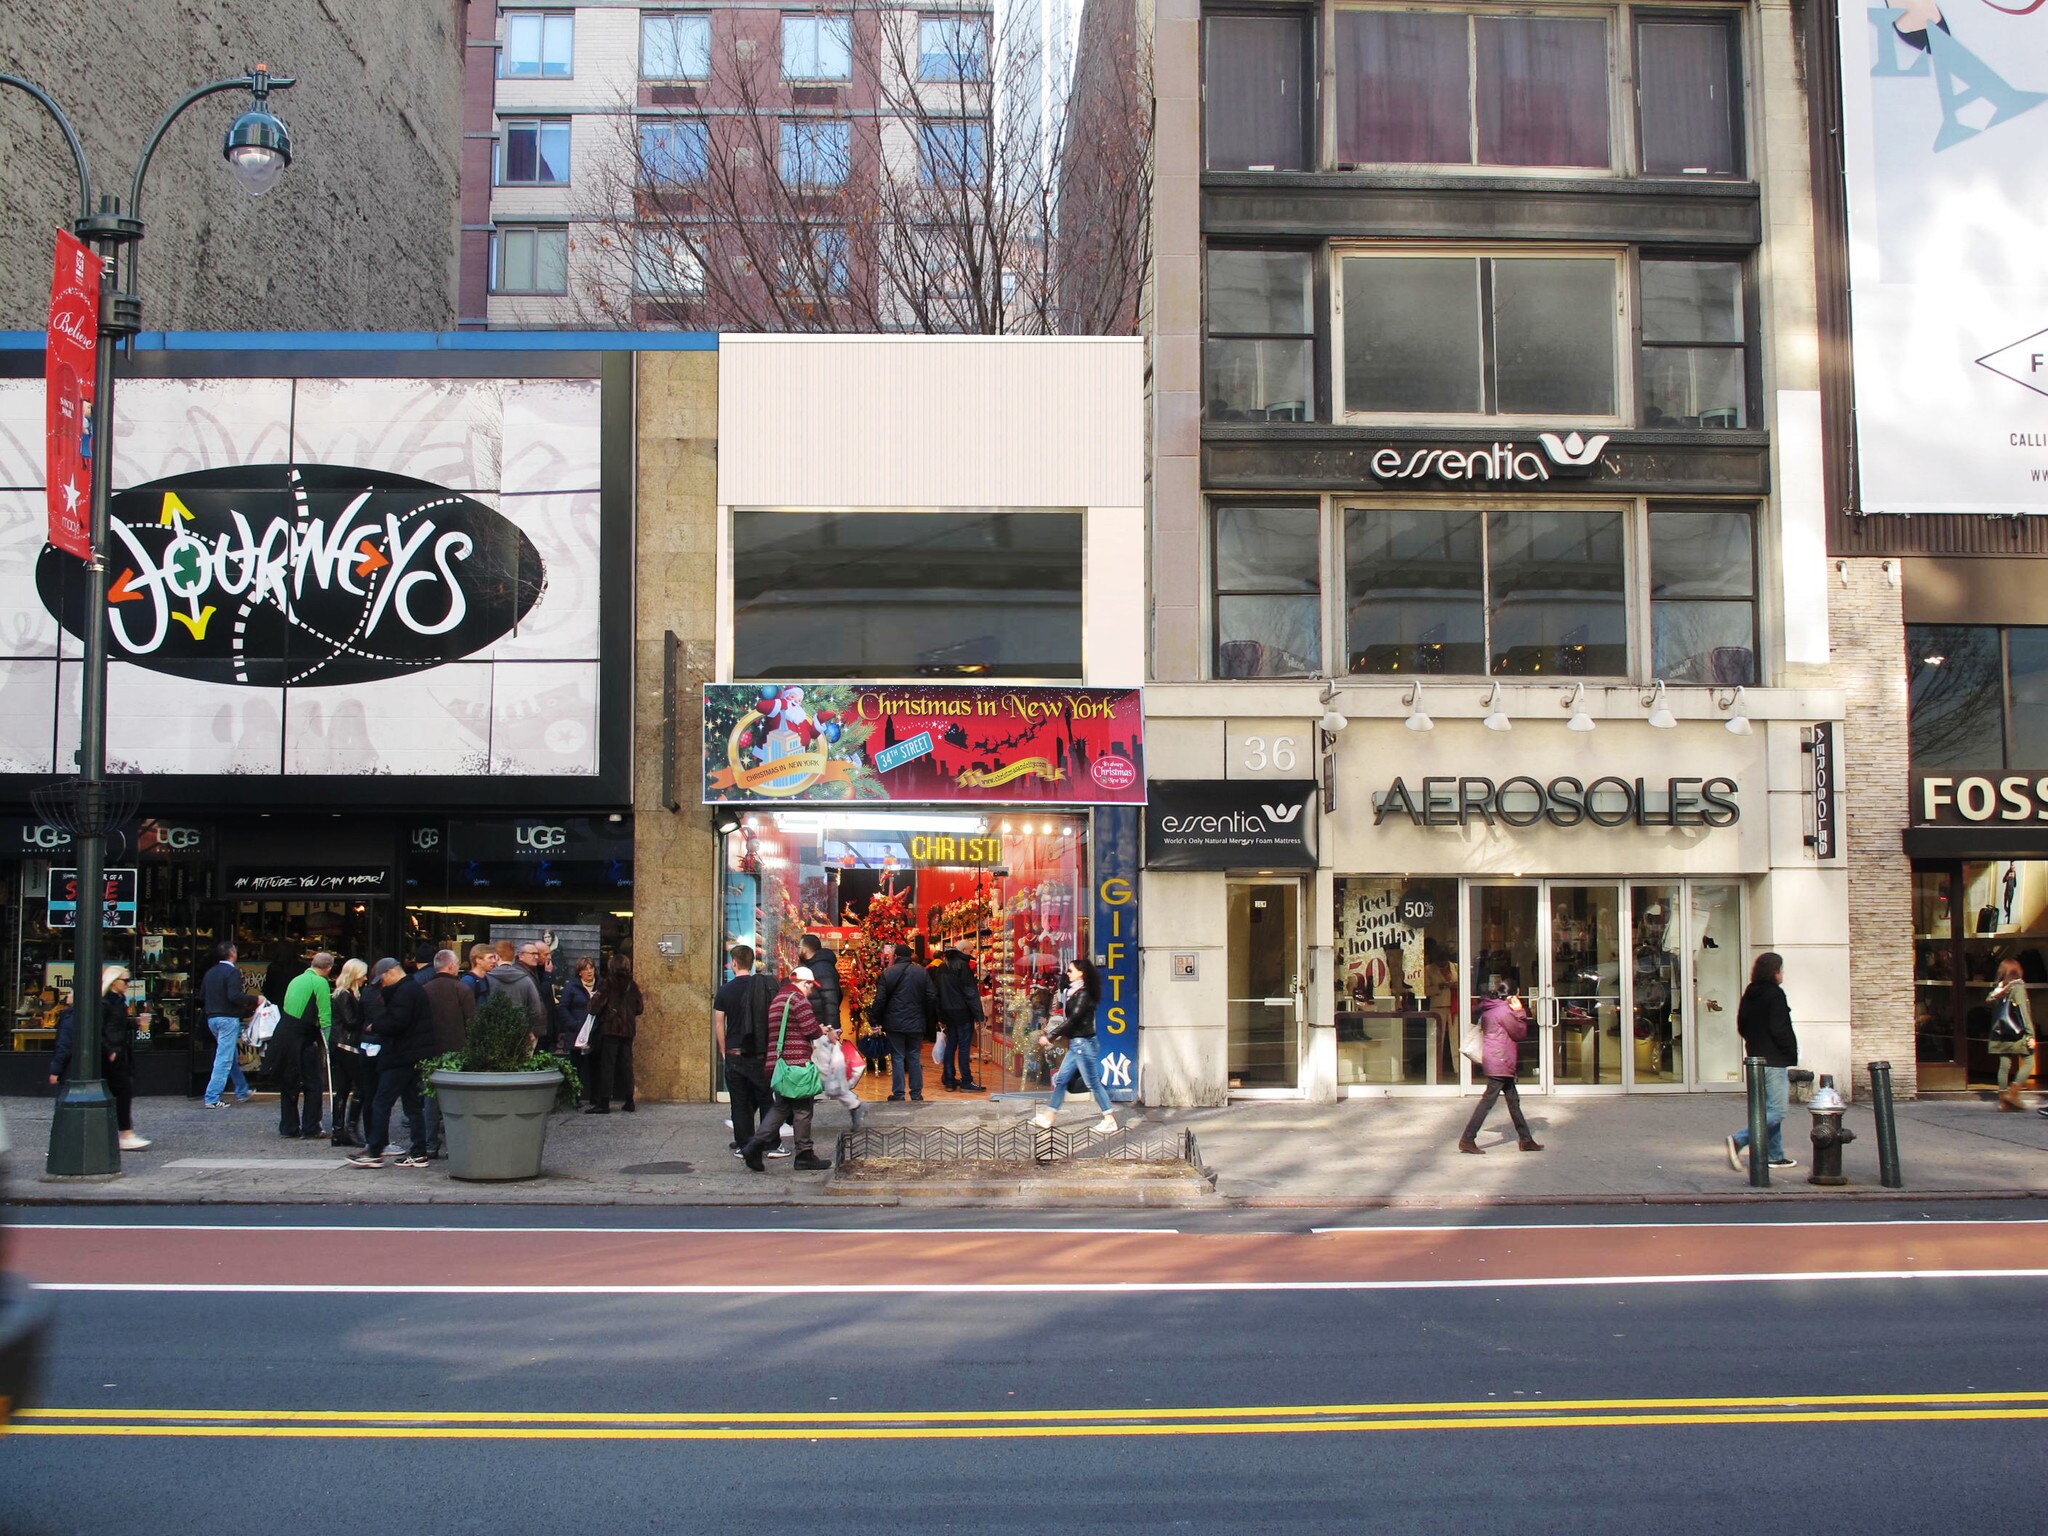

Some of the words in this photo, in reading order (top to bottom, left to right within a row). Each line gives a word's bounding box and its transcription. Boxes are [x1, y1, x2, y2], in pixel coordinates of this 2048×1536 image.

[53, 312, 97, 349] Believe
[1370, 442, 1550, 481] essentia
[857, 692, 972, 720] Christmas
[976, 693, 998, 717] in
[1001, 694, 1063, 724] New
[1064, 695, 1118, 719] York
[880, 751, 899, 768] 34TH
[901, 738, 929, 759] STREET
[1243, 736, 1296, 771] 36
[746, 766, 779, 783] CHRISTMAS
[779, 765, 787, 773] IN
[788, 761, 802, 769] NEW
[803, 759, 820, 768] YORK
[1093, 765, 1132, 778] Christmas
[1374, 775, 1741, 828] AEROSOLES
[1814, 727, 1829, 857] AEROSOLES
[1161, 811, 1267, 833] essentia
[22, 825, 72, 848] UGG
[157, 827, 201, 848] UGG
[412, 828, 440, 849] UGG
[516, 825, 567, 850] UGG
[1163, 837, 1188, 845] World's
[1189, 837, 1204, 846] Only
[1204, 837, 1228, 845] Natural
[1255, 837, 1274, 845] Foam
[1274, 837, 1301, 845] Mattress
[234, 877, 250, 889] AN
[250, 875, 299, 891] ATTITUDE
[299, 874, 320, 888] YOU
[321, 876, 345, 890] CAN
[1359, 889, 1392, 914] feel
[1356, 905, 1401, 936] good
[1348, 927, 1416, 955] holiday
[1100, 878, 1133, 1035] GIFTS
[1407, 969, 1422, 980] off
